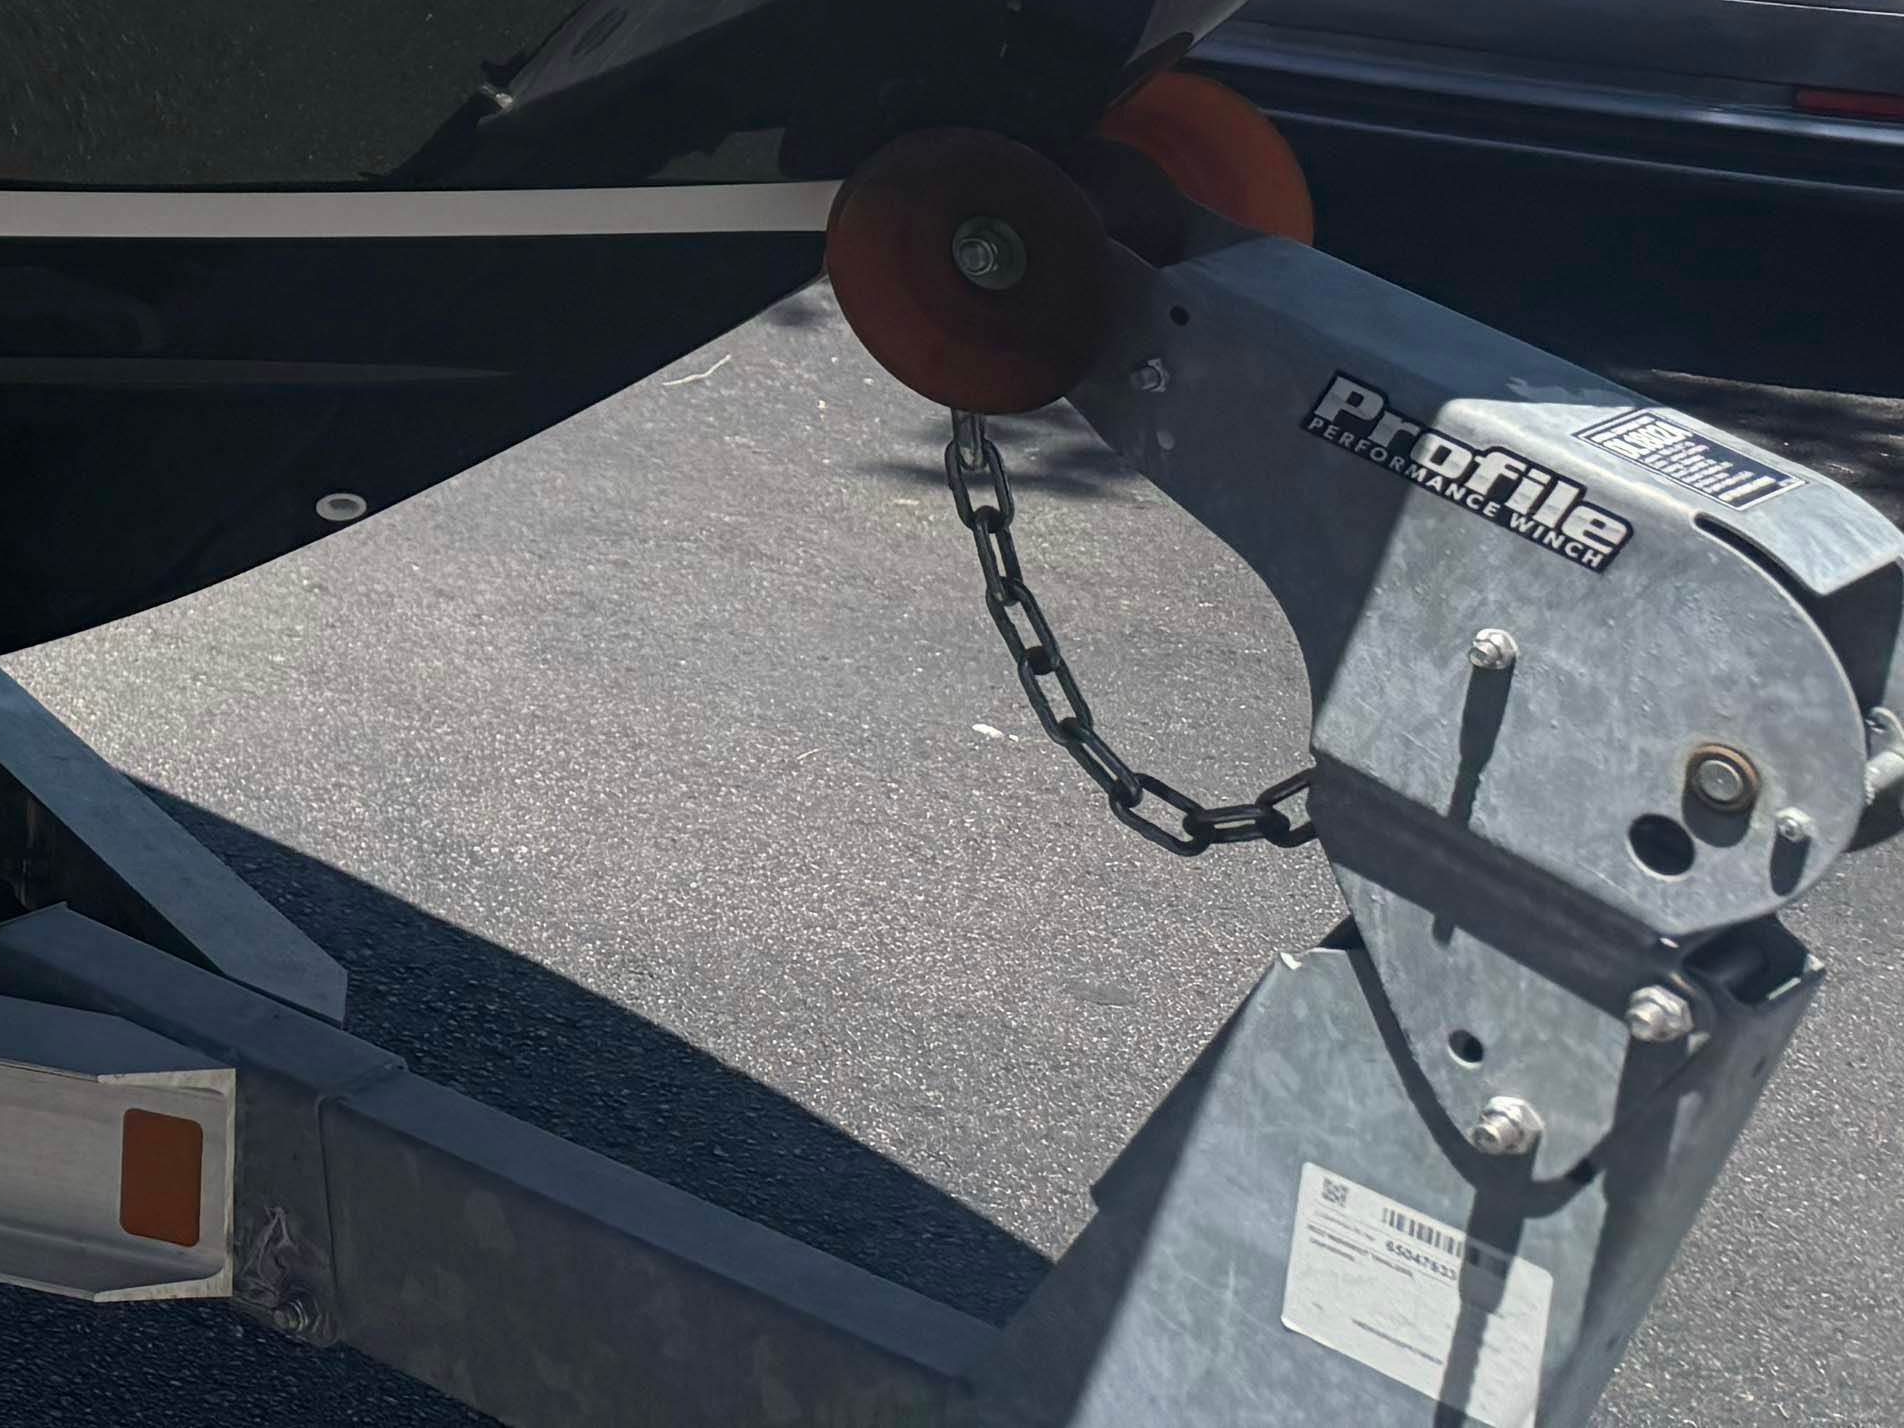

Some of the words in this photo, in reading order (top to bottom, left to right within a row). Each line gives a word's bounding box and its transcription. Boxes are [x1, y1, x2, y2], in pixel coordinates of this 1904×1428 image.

[1308, 417, 1497, 517] PERFORMANCE
[1510, 511, 1604, 569] WINCH
[1313, 376, 1629, 554] Profile
